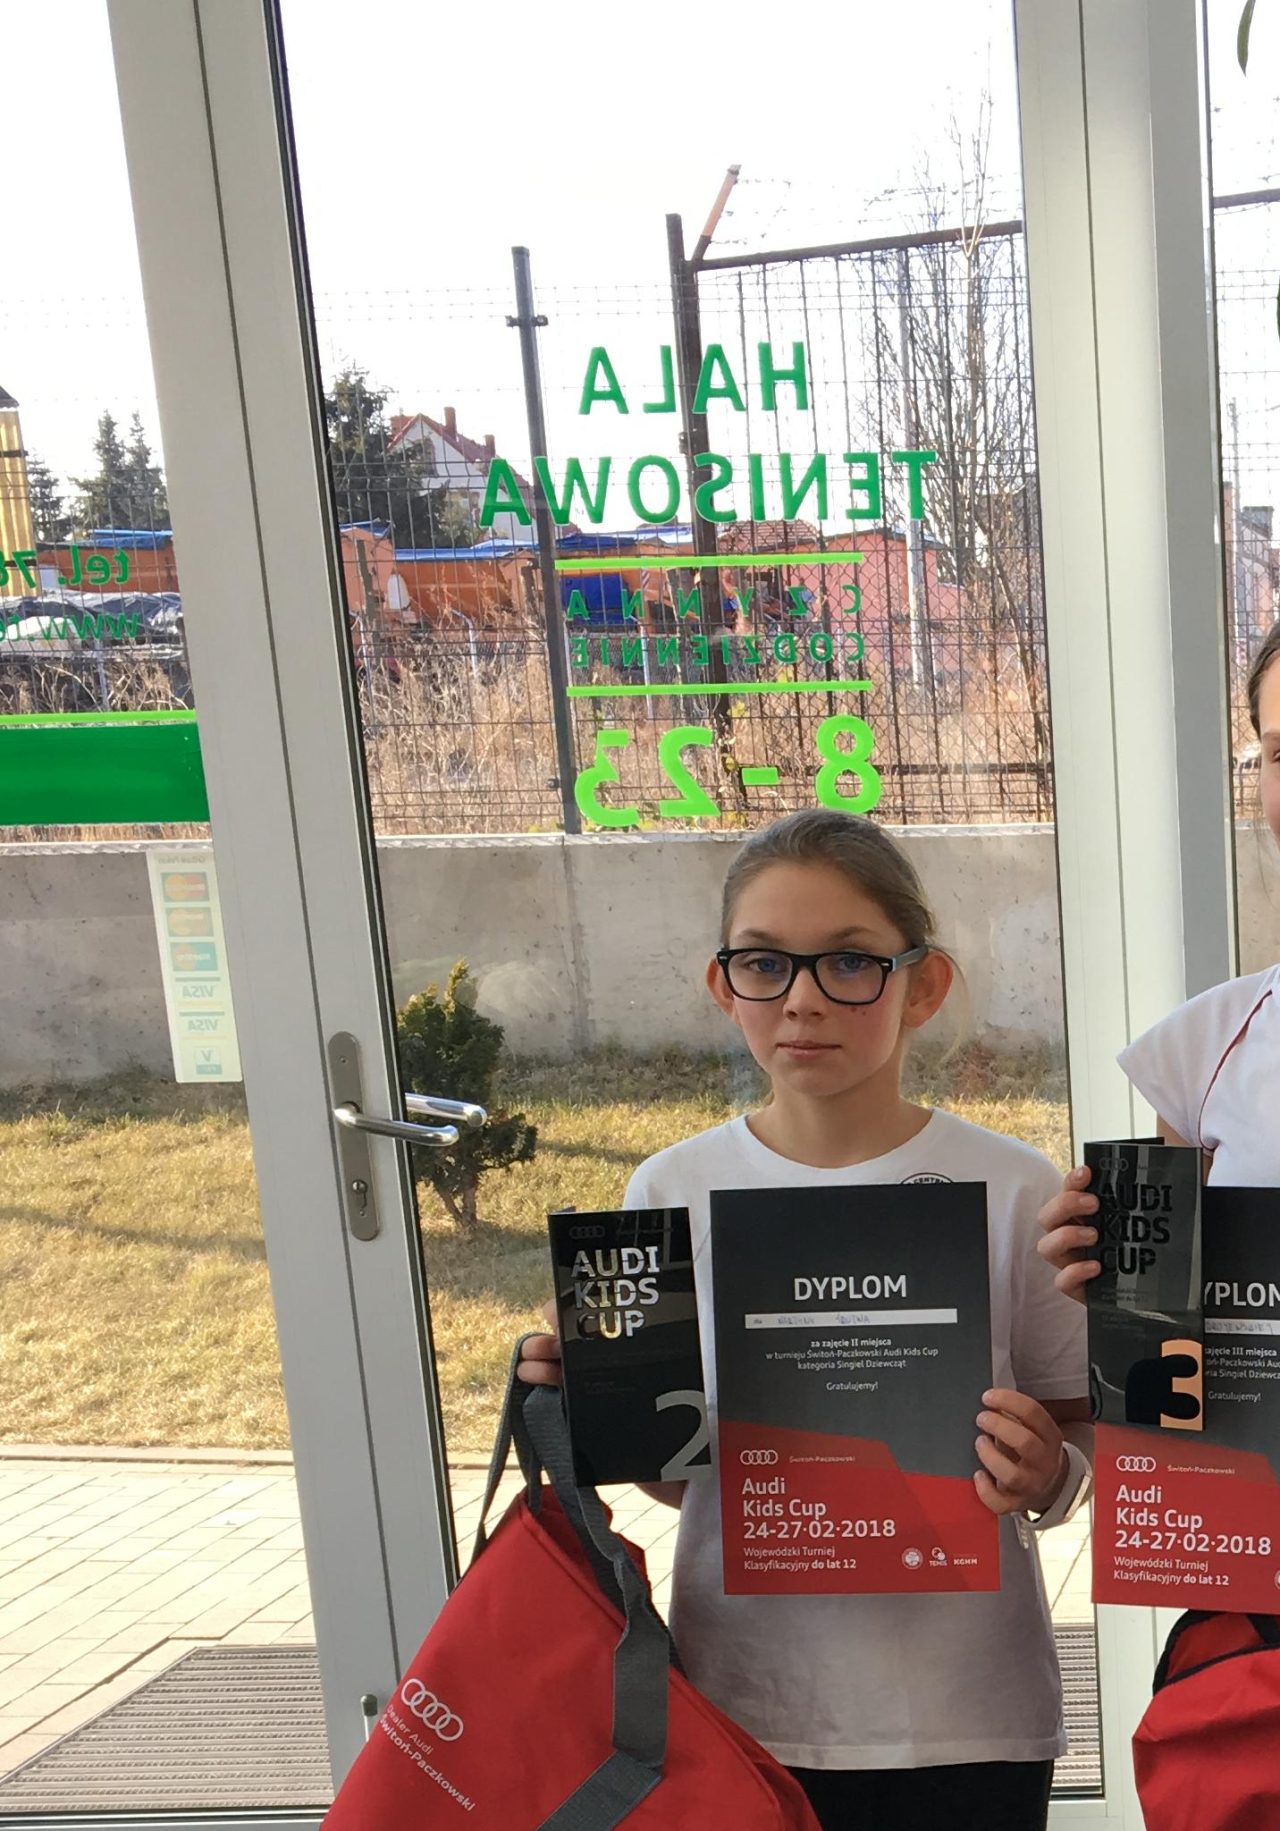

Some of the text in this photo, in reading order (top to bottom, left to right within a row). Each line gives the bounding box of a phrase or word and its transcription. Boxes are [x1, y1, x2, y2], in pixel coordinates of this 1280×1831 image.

[1102, 1183, 1173, 1213] AUDI
[1101, 1215, 1171, 1244] KIDS
[571, 1246, 660, 1278] AUDI
[1103, 1247, 1156, 1275] CUP
[573, 1277, 660, 1309] KIDS
[794, 1275, 907, 1300] DYPLOM
[577, 1310, 645, 1340] CUP
[822, 1338, 849, 1349] zajęcie
[851, 1338, 859, 1347] II
[861, 1338, 892, 1348] miejsca
[1232, 1347, 1244, 1355] III
[1245, 1349, 1277, 1358] miejsca
[775, 1350, 806, 1362] turnieju
[884, 1348, 902, 1357] Audi
[904, 1347, 921, 1357] Kids
[923, 1347, 939, 1358] Cup
[798, 1360, 835, 1371] kategoria
[866, 1358, 906, 1369] Dziewcząt
[826, 1381, 879, 1391] Gratulujemy!
[1208, 1390, 1261, 1402] Gratulujemy!
[656, 1389, 712, 1483] 2
[742, 1477, 785, 1495] Audi
[1116, 1485, 1162, 1504] Audi
[743, 1499, 827, 1520] Kids Cup
[1116, 1507, 1203, 1533] Kids Cup
[743, 1546, 835, 1559] Wojewódzki Turniej
[744, 1559, 857, 1573] Klasyfikacyjny do lat 12
[1114, 1556, 1209, 1571] Wojewódzki Turniej
[1113, 1570, 1230, 1586] Klasyfikacyjny do lat 12
[409, 1733, 434, 1755] Audi
